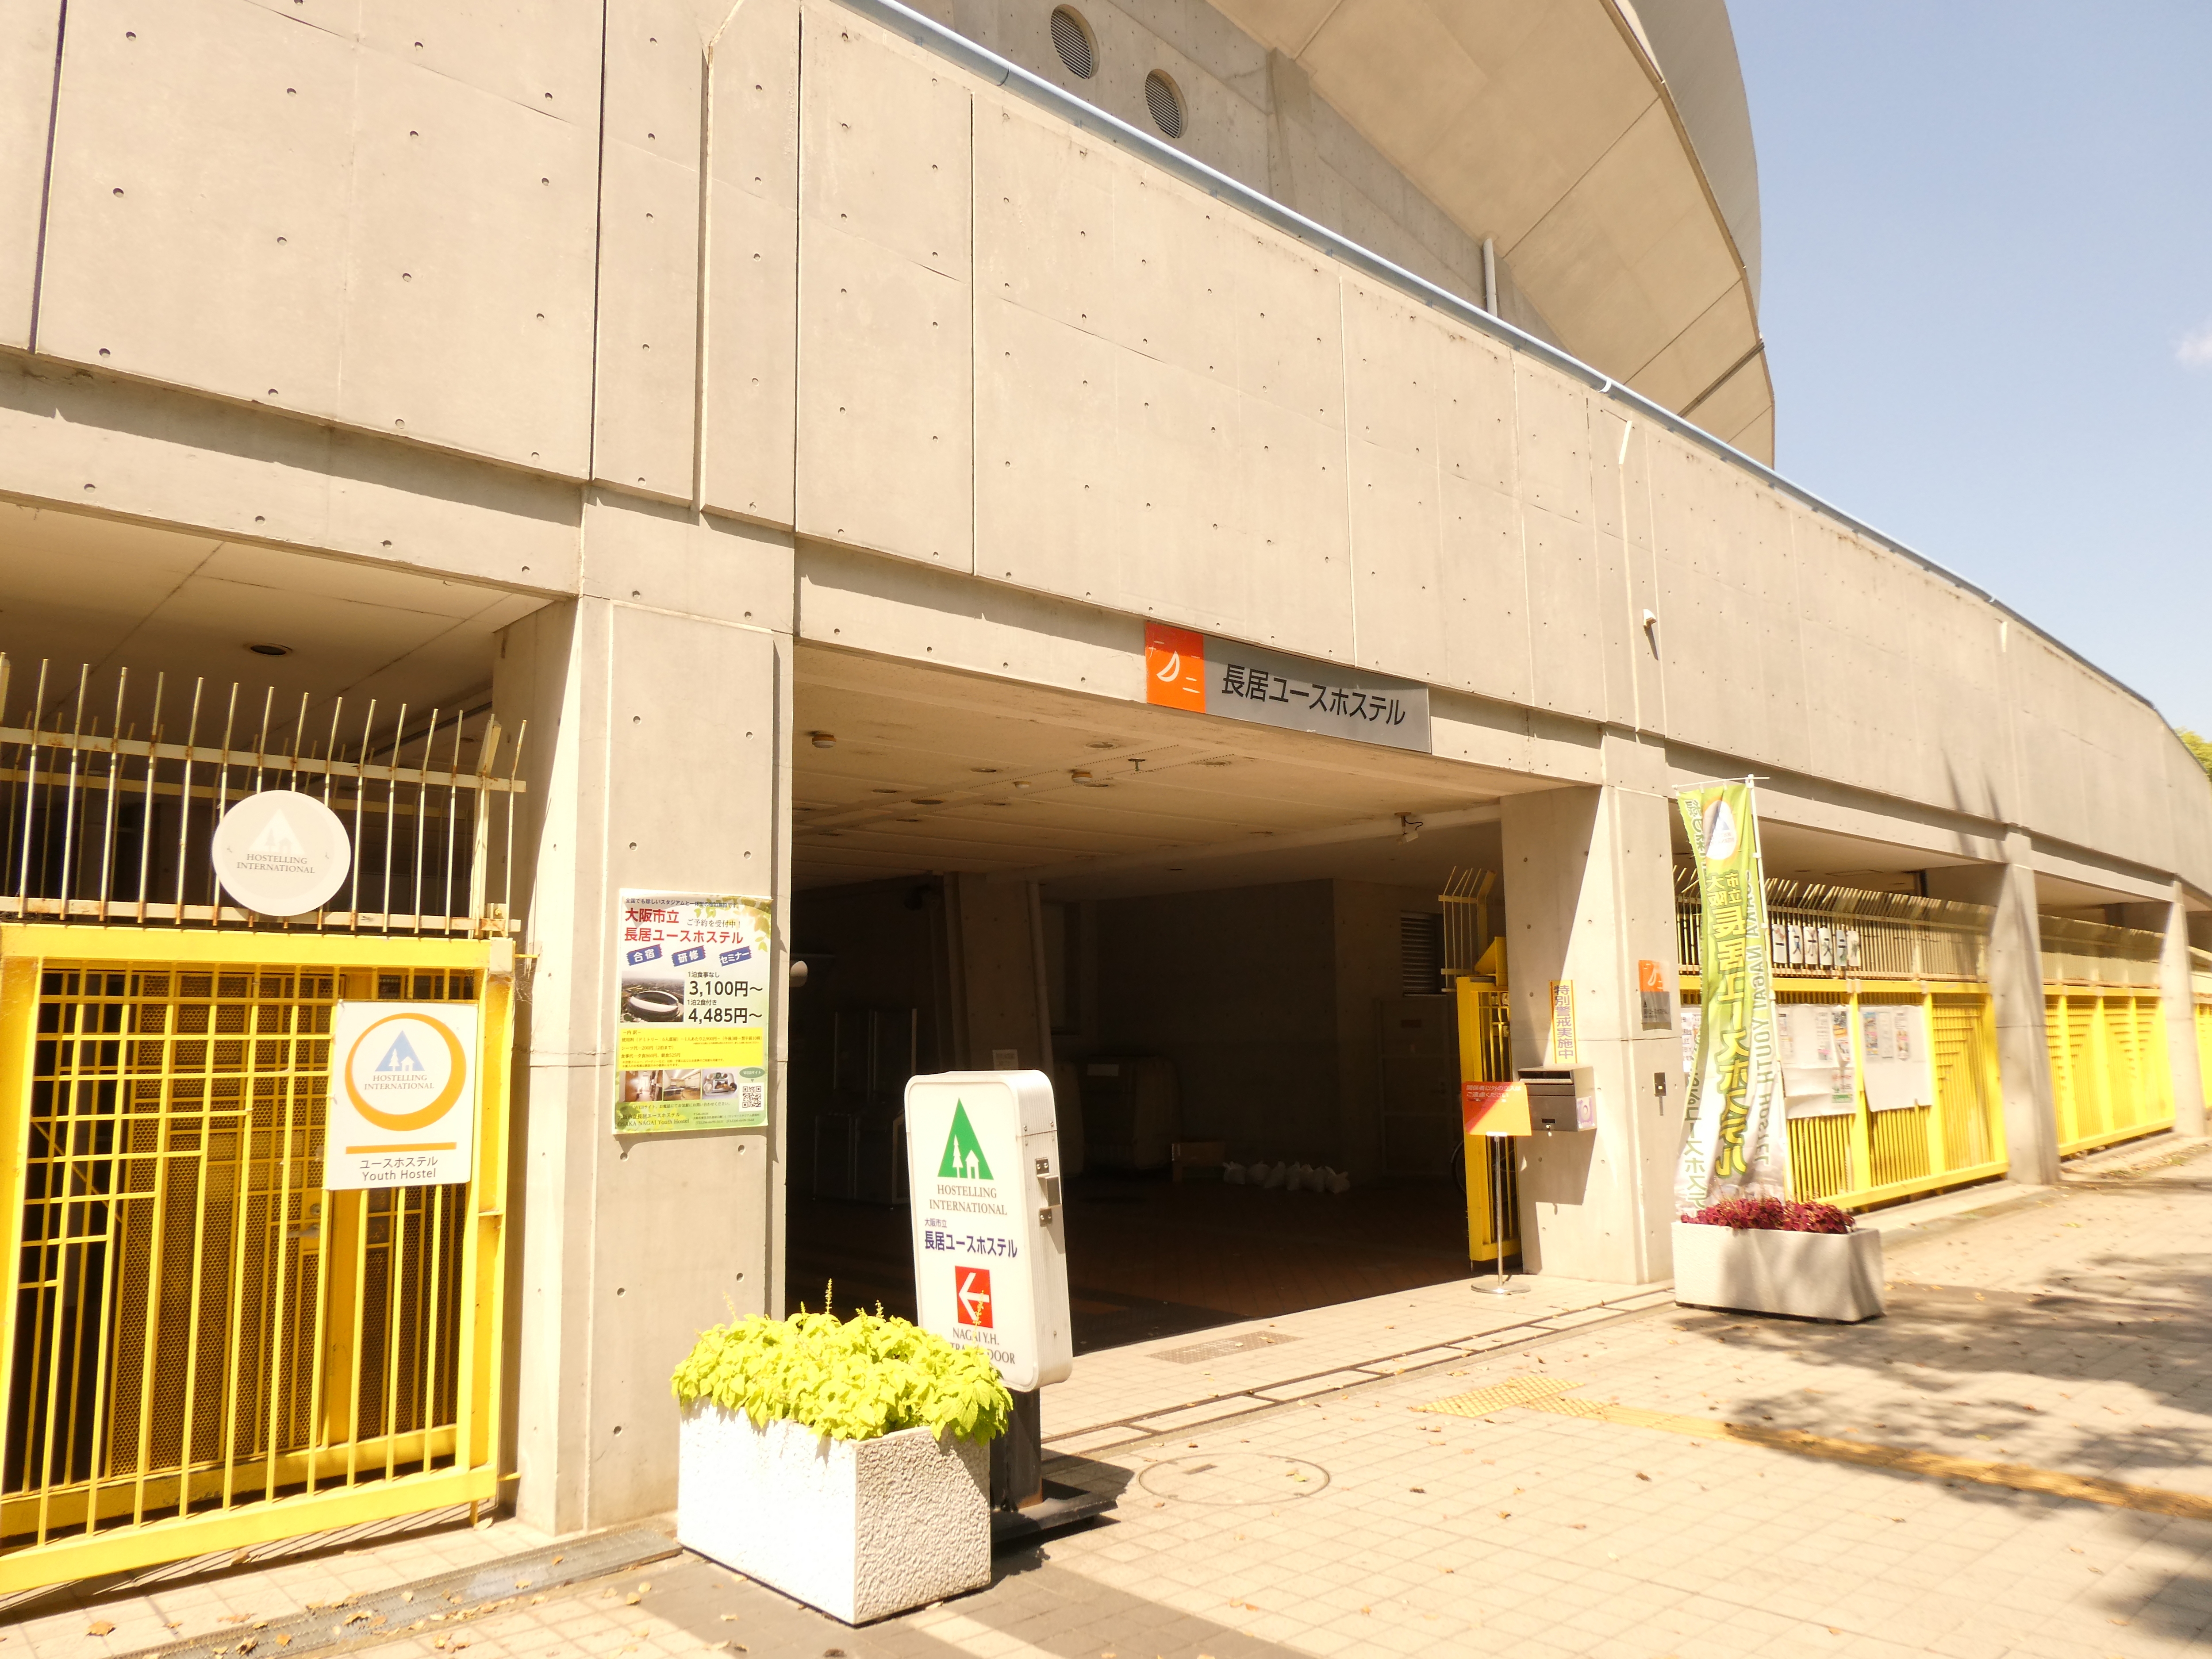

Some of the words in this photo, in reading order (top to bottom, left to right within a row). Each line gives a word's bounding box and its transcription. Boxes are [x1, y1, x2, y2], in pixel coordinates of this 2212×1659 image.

[1221, 664, 1406, 726] 長居ユースホステル
[246, 853, 308, 865] HOSTELLING
[236, 861, 315, 875] INTERNATIONAL
[625, 907, 680, 924] 大阪市立
[624, 927, 743, 944] 長居ユースホステル
[633, 949, 655, 962] 合宿
[677, 949, 699, 964] 研修
[720, 951, 750, 964] セミナー
[689, 980, 763, 997] 3,100円～
[688, 1007, 762, 1024] 4,485円～
[1553, 984, 1574, 1060] 特別警戒実施中
[364, 1082, 434, 1091] INTERNATIONAL
[359, 1156, 438, 1168] ユースホステル
[361, 1169, 395, 1182] Youth
[400, 1167, 436, 1180] Hostel
[937, 1184, 997, 1199] HOSTELLING
[929, 1199, 1008, 1216] INTERNATIONAL
[924, 1217, 948, 1228] 大阪市立
[924, 1230, 1018, 1259] 長居ユースホステル
[952, 1327, 981, 1342] NAGAI
[982, 1332, 1000, 1345] Y.H.
